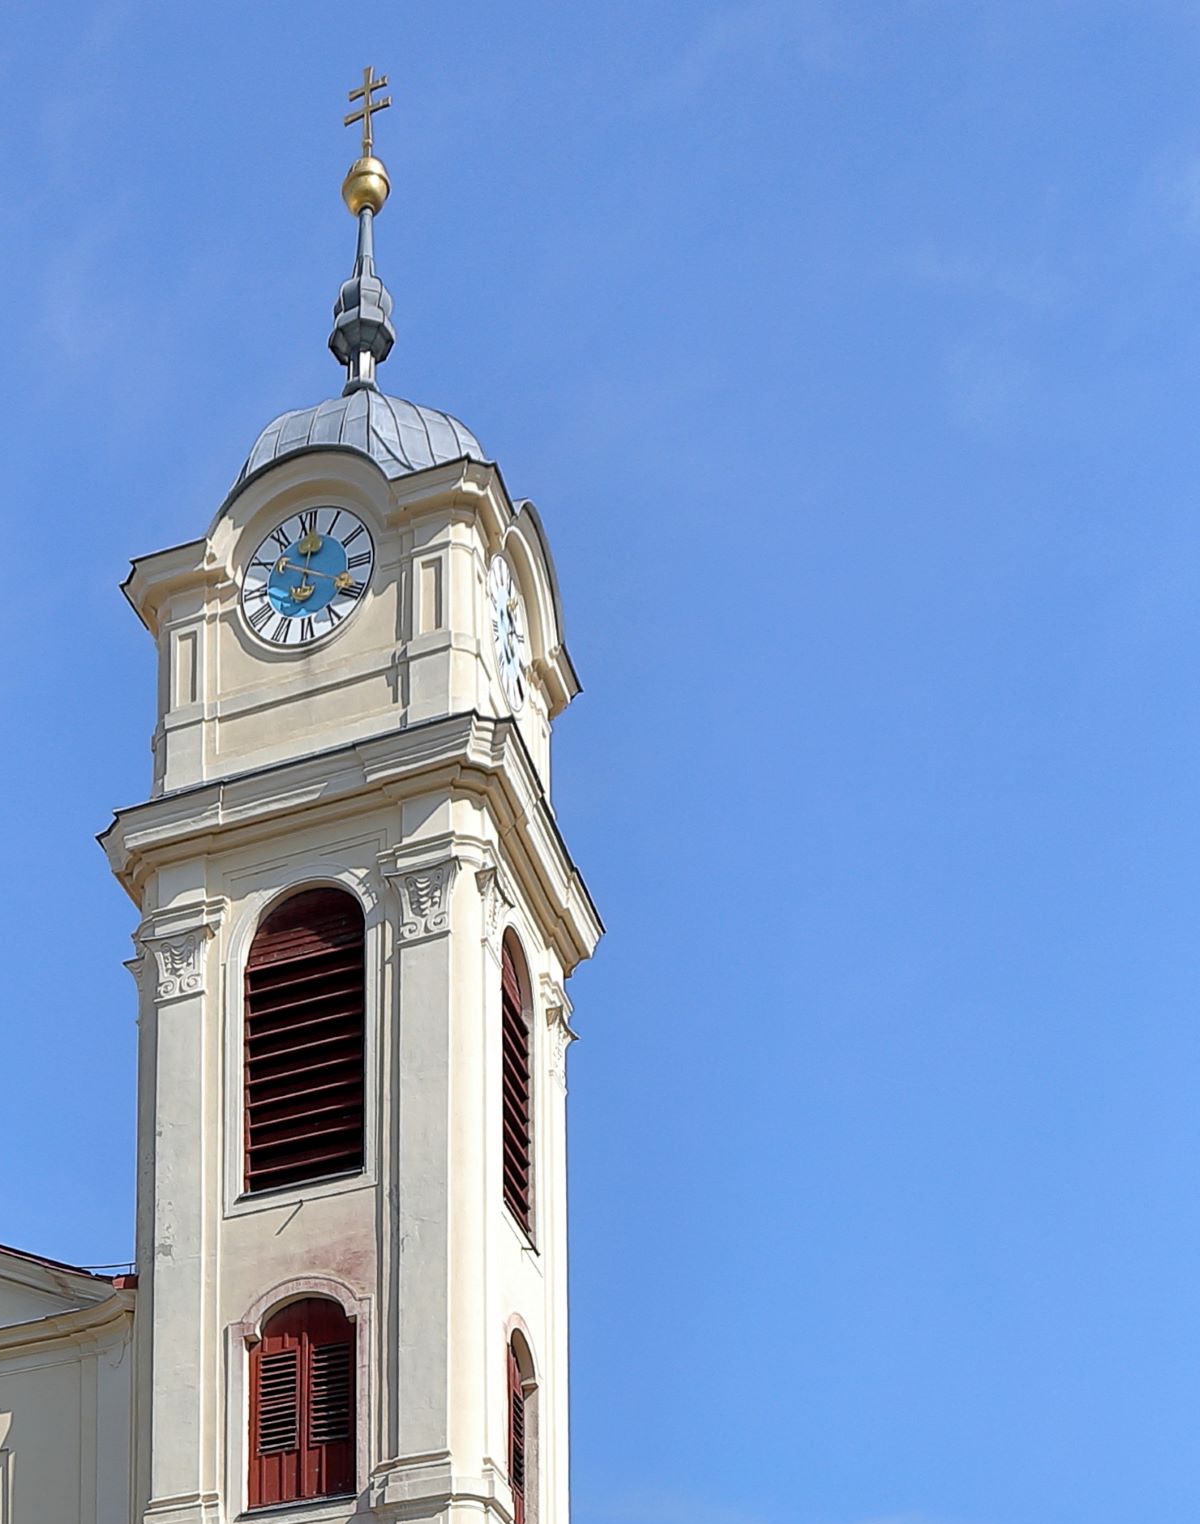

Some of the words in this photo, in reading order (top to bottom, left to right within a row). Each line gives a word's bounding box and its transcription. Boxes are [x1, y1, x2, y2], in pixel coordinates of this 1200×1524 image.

[298, 509, 318, 539] XII
[327, 510, 341, 535] I
[270, 527, 292, 554] XI
[341, 524, 365, 548] II
[251, 556, 275, 572] X
[347, 551, 371, 569] III
[244, 582, 268, 603] IX
[248, 601, 275, 633] VIII
[326, 604, 343, 627] V
[271, 616, 293, 643] VII
[300, 616, 315, 641] VI
